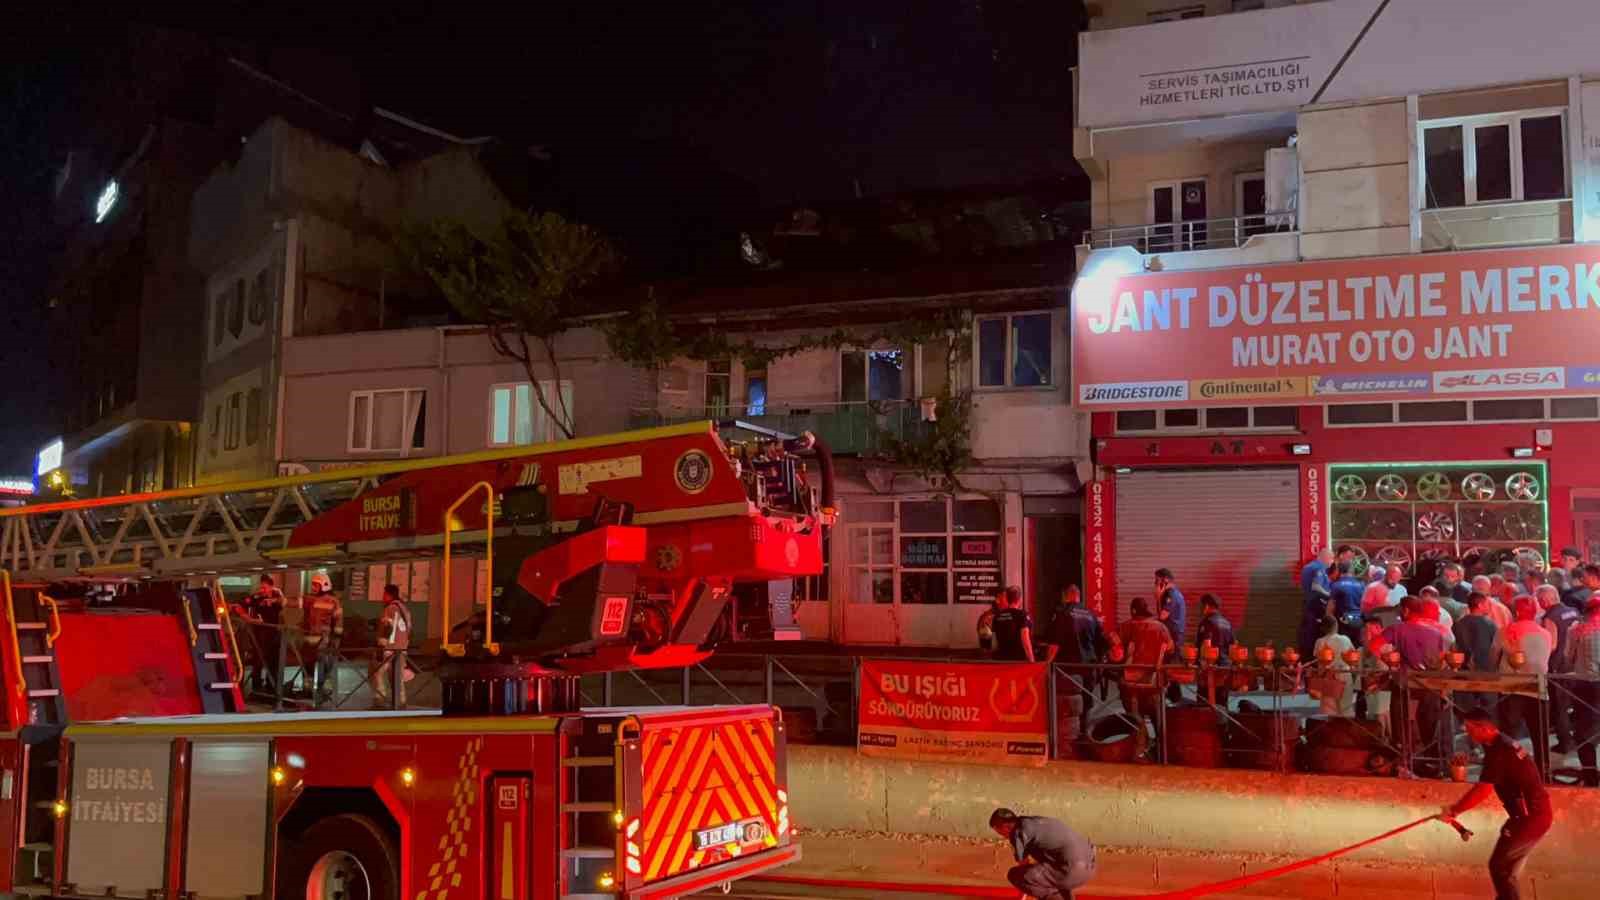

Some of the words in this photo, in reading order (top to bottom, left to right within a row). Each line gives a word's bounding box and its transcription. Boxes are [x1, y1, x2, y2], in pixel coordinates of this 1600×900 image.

[1147, 76, 1199, 91] SERVİS
[1205, 63, 1300, 84] TAŞIMACILIĞI
[1139, 84, 1224, 106] HİZMETLERİ
[1088, 287, 1198, 334] JANT
[1208, 271, 1446, 328] DÜZELTME
[1460, 262, 1600, 315] MERK
[1232, 333, 1341, 368] MURAT
[1349, 329, 1415, 363] OTO
[1424, 325, 1513, 360] JANT
[1200, 380, 1281, 398] Continental
[1341, 379, 1428, 391] MICHELIN
[1468, 371, 1560, 386] LASSA
[1084, 384, 1183, 400] BRIDGESTONE
[1308, 467, 1318, 515] 0531
[363, 496, 400, 513] BURSA
[1092, 483, 1103, 527] 0532
[607, 601, 623, 618] 112
[880, 673, 909, 694] BU
[915, 672, 967, 698] IŞIĞI
[868, 698, 981, 722] SÖNDÜRÜYORUZ
[86, 768, 154, 791] BURSA
[502, 788, 515, 800] 112
[74, 796, 164, 824] İTFAİYESİ
